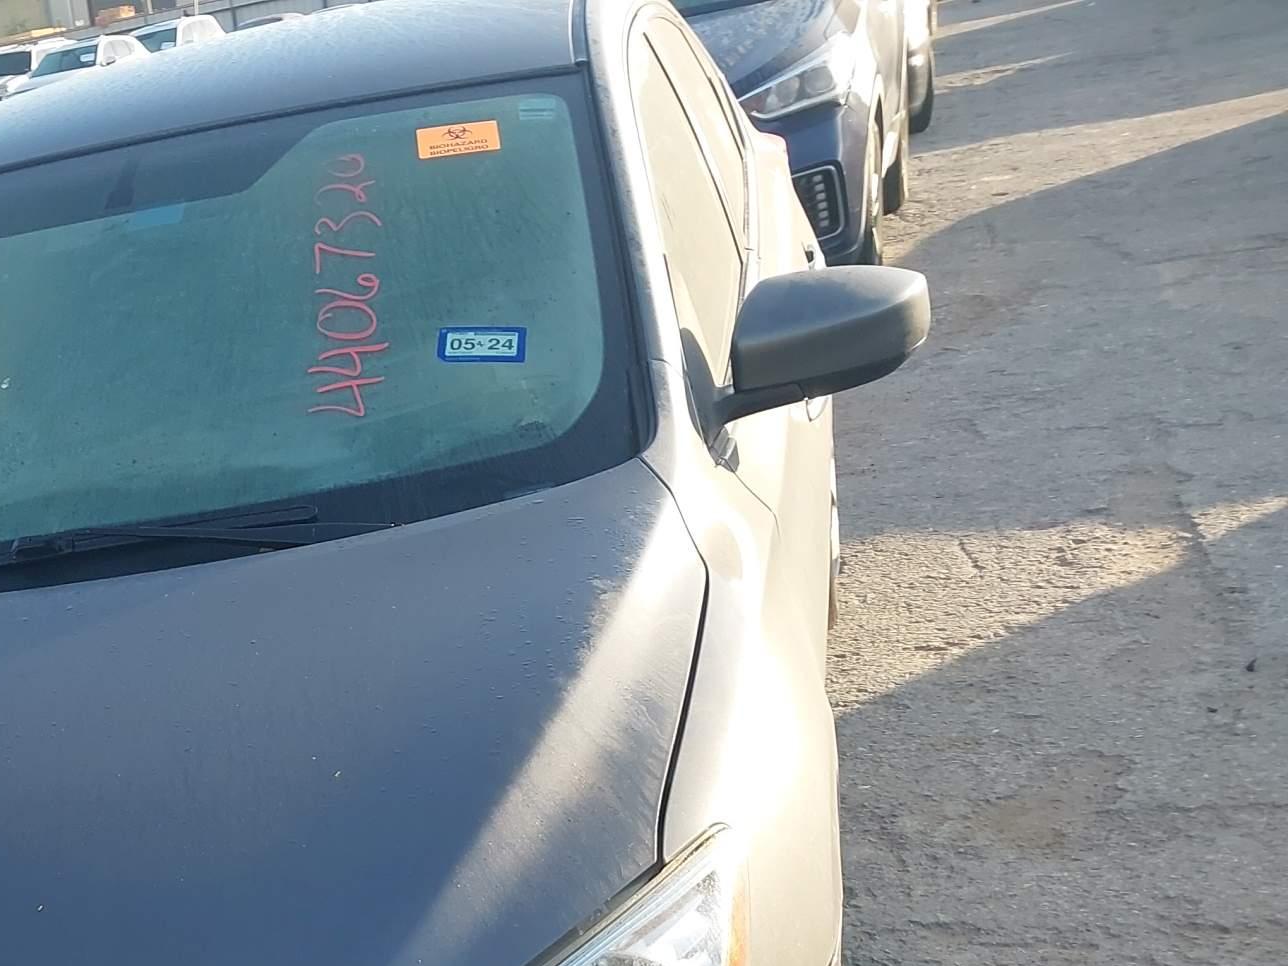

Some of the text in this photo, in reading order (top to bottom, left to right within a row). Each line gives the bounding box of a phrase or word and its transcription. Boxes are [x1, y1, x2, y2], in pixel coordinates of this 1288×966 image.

[429, 138, 488, 150] BIOHAZARD
[429, 144, 489, 156] BIOPELIGRO
[307, 153, 390, 417] 44067320
